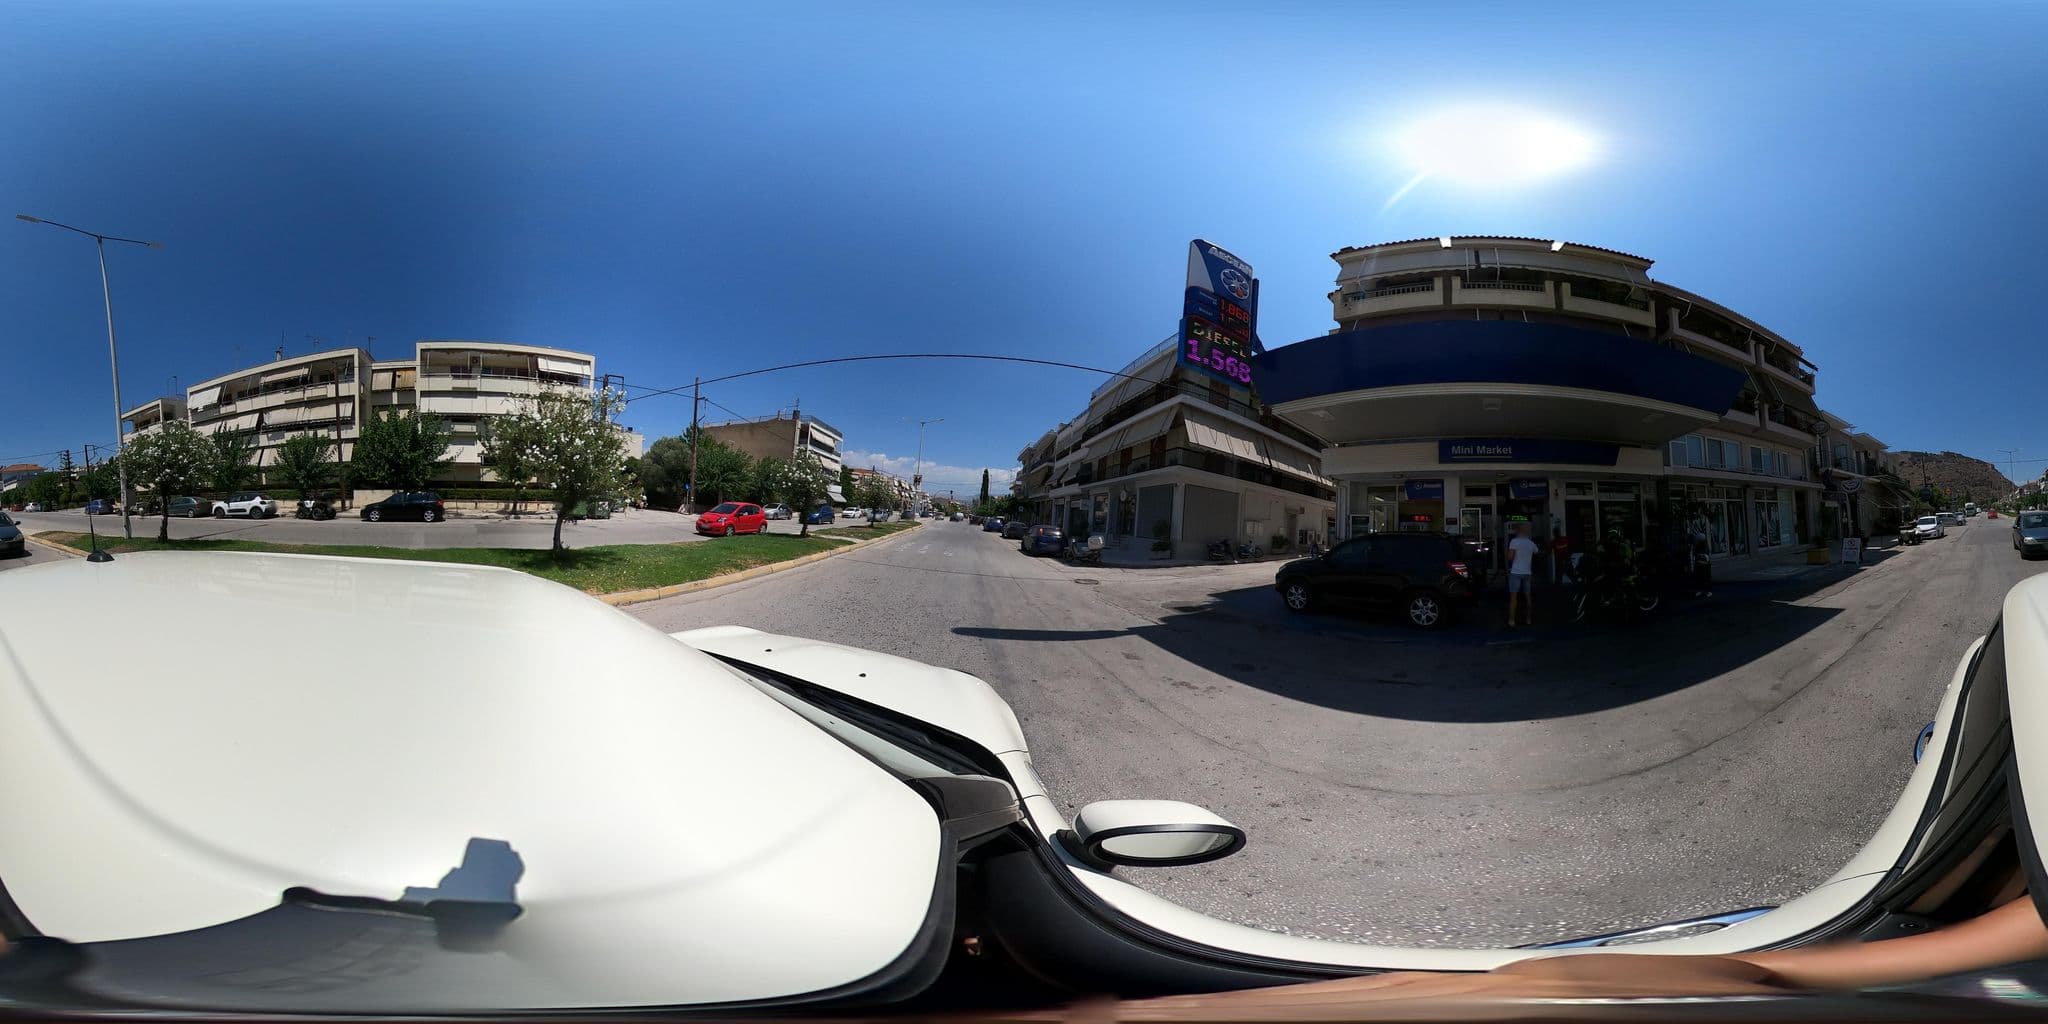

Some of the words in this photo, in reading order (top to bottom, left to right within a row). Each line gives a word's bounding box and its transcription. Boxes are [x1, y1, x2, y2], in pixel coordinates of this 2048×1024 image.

[1193, 321, 1249, 358] DIESEL
[1186, 338, 1252, 384] 1.568
[1451, 445, 1473, 455] Mini
[1476, 445, 1513, 455] Market
